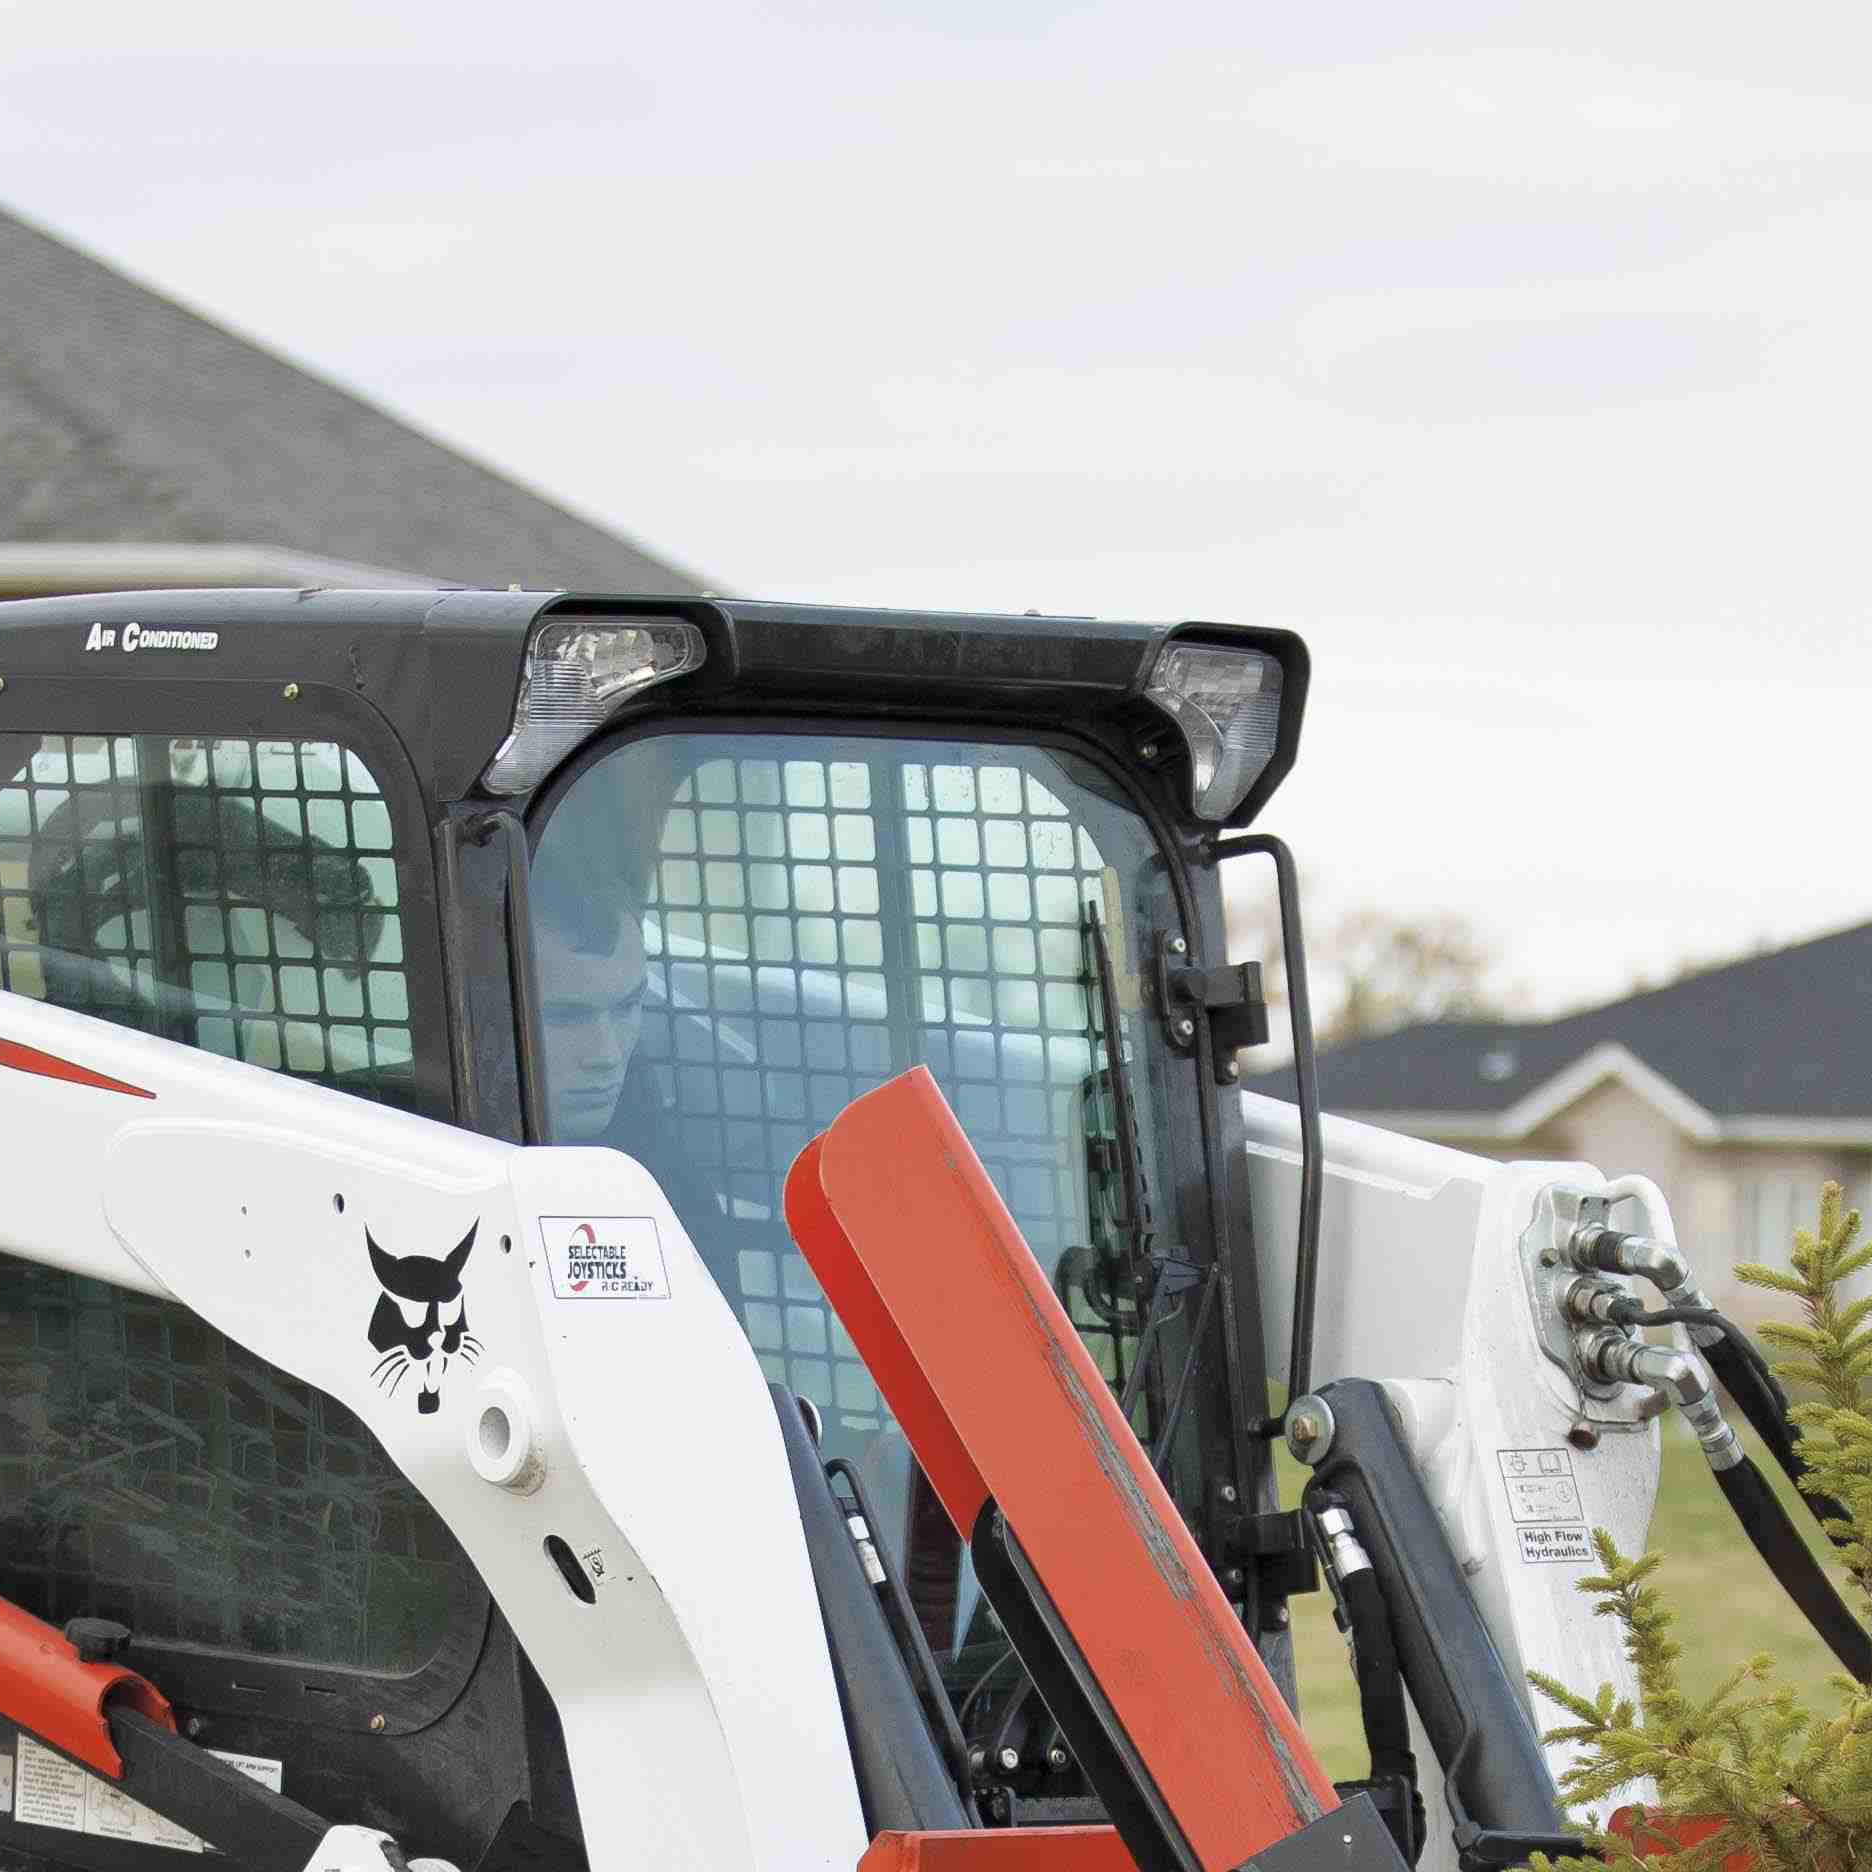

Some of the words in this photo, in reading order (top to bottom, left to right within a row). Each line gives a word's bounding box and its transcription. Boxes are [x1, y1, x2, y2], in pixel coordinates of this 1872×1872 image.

[568, 1245, 626, 1260] SELECTABLE
[568, 1261, 626, 1279] JOYSTICKS
[1524, 1530, 1552, 1544] High
[1555, 1530, 1583, 1542] Flow
[1525, 1546, 1589, 1559] Hydraulics
